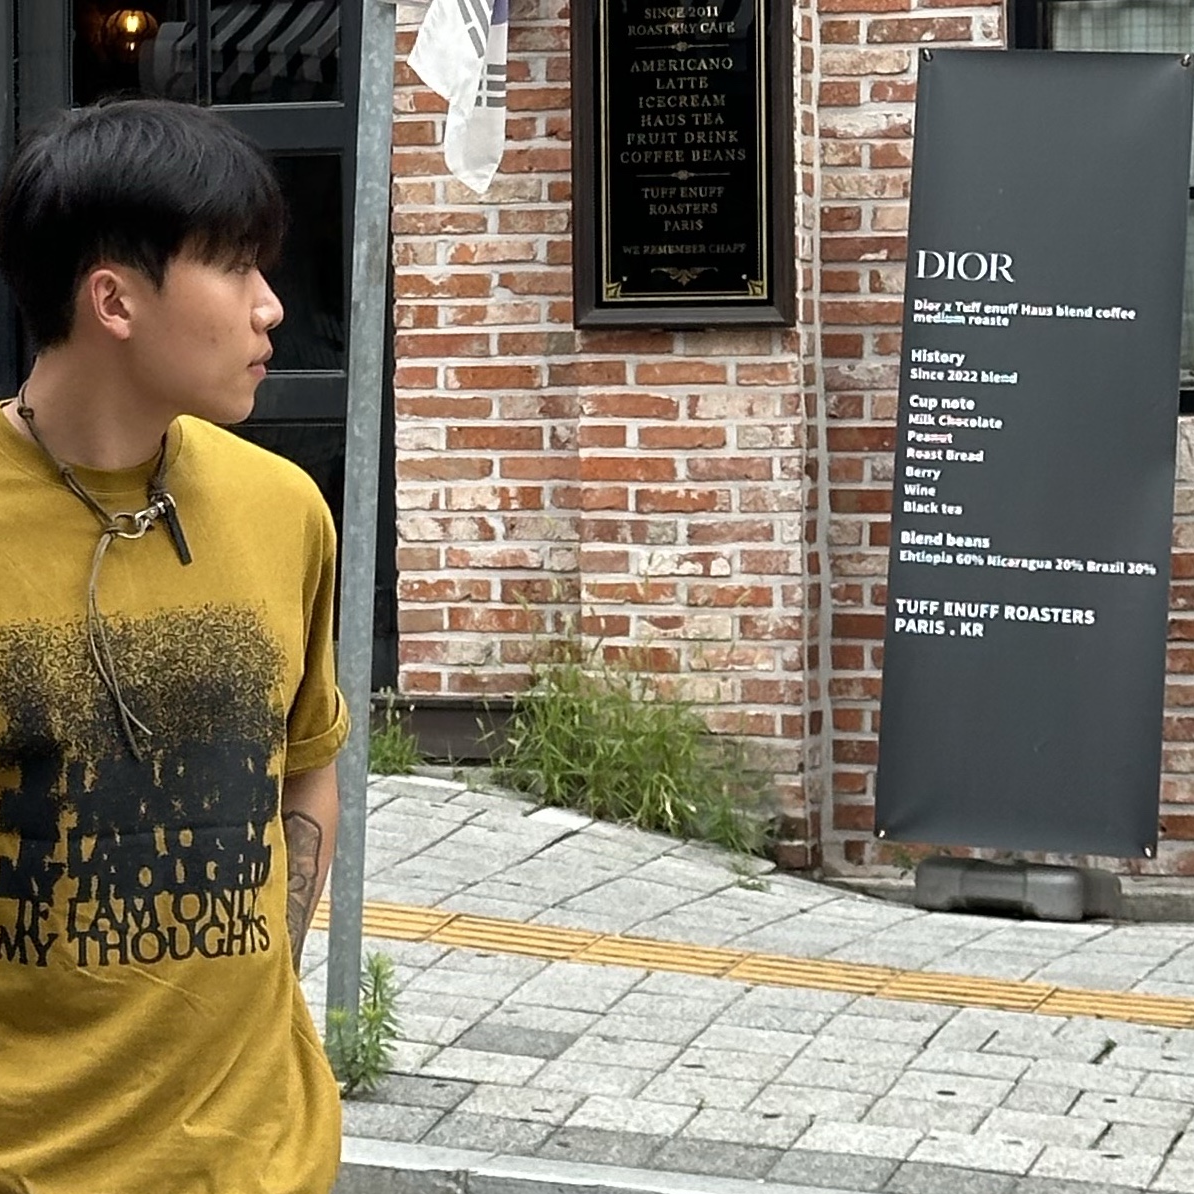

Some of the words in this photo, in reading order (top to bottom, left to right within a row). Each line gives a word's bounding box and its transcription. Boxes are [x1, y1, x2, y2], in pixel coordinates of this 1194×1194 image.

[644, 5, 687, 19] SINCE
[688, 5, 720, 19] 2011
[630, 57, 734, 73] AMERICANO
[656, 76, 710, 90] LATTE
[638, 94, 727, 109] ICECREAM
[640, 112, 687, 127] HAUS
[691, 112, 725, 126] TEA
[626, 131, 678, 146] FRUIT
[684, 130, 740, 145] DRINK
[620, 150, 685, 164] COFFEE
[691, 148, 747, 162] BEANS
[641, 187, 677, 199] TUFF
[680, 186, 725, 199] ENUFF
[648, 203, 718, 216] ROASTERS
[663, 219, 704, 232] PARIS
[916, 249, 1015, 283] DIOR
[914, 298, 942, 312] Dior
[943, 302, 952, 313] x
[954, 301, 982, 314] Tuff
[983, 302, 1019, 315] enuff
[1020, 303, 1054, 317] Haus
[1055, 304, 1093, 318] blend
[1095, 306, 1136, 320] coffee
[913, 310, 967, 325] medium
[911, 348, 966, 367] History
[909, 367, 945, 381] Since
[947, 369, 978, 383] 2022
[980, 370, 1018, 384] blend
[909, 394, 939, 411] Cup
[941, 397, 976, 411] note
[908, 413, 936, 426] Milk
[938, 414, 1003, 430] Chocolate
[907, 429, 953, 444] Peanut
[906, 446, 943, 461] Roast
[945, 449, 985, 463] Bread
[905, 465, 941, 481] Berry
[903, 483, 936, 497] Wine
[903, 500, 939, 514] Black
[941, 503, 963, 516] tea
[900, 530, 944, 546] Blend
[946, 532, 990, 549] beans
[955, 552, 985, 566] 60%
[986, 554, 1053, 572] Nicaragua
[1055, 558, 1085, 572] 20%
[1086, 560, 1125, 574] Brazil
[1127, 562, 1157, 576] 20%
[895, 598, 940, 616] TUFF
[943, 601, 1000, 619] ENUFF
[1003, 604, 1095, 625] ROASTERS
[894, 617, 946, 635] PARIS
[960, 621, 984, 638] KR
[67, 914, 270, 966] THOUGHTS
